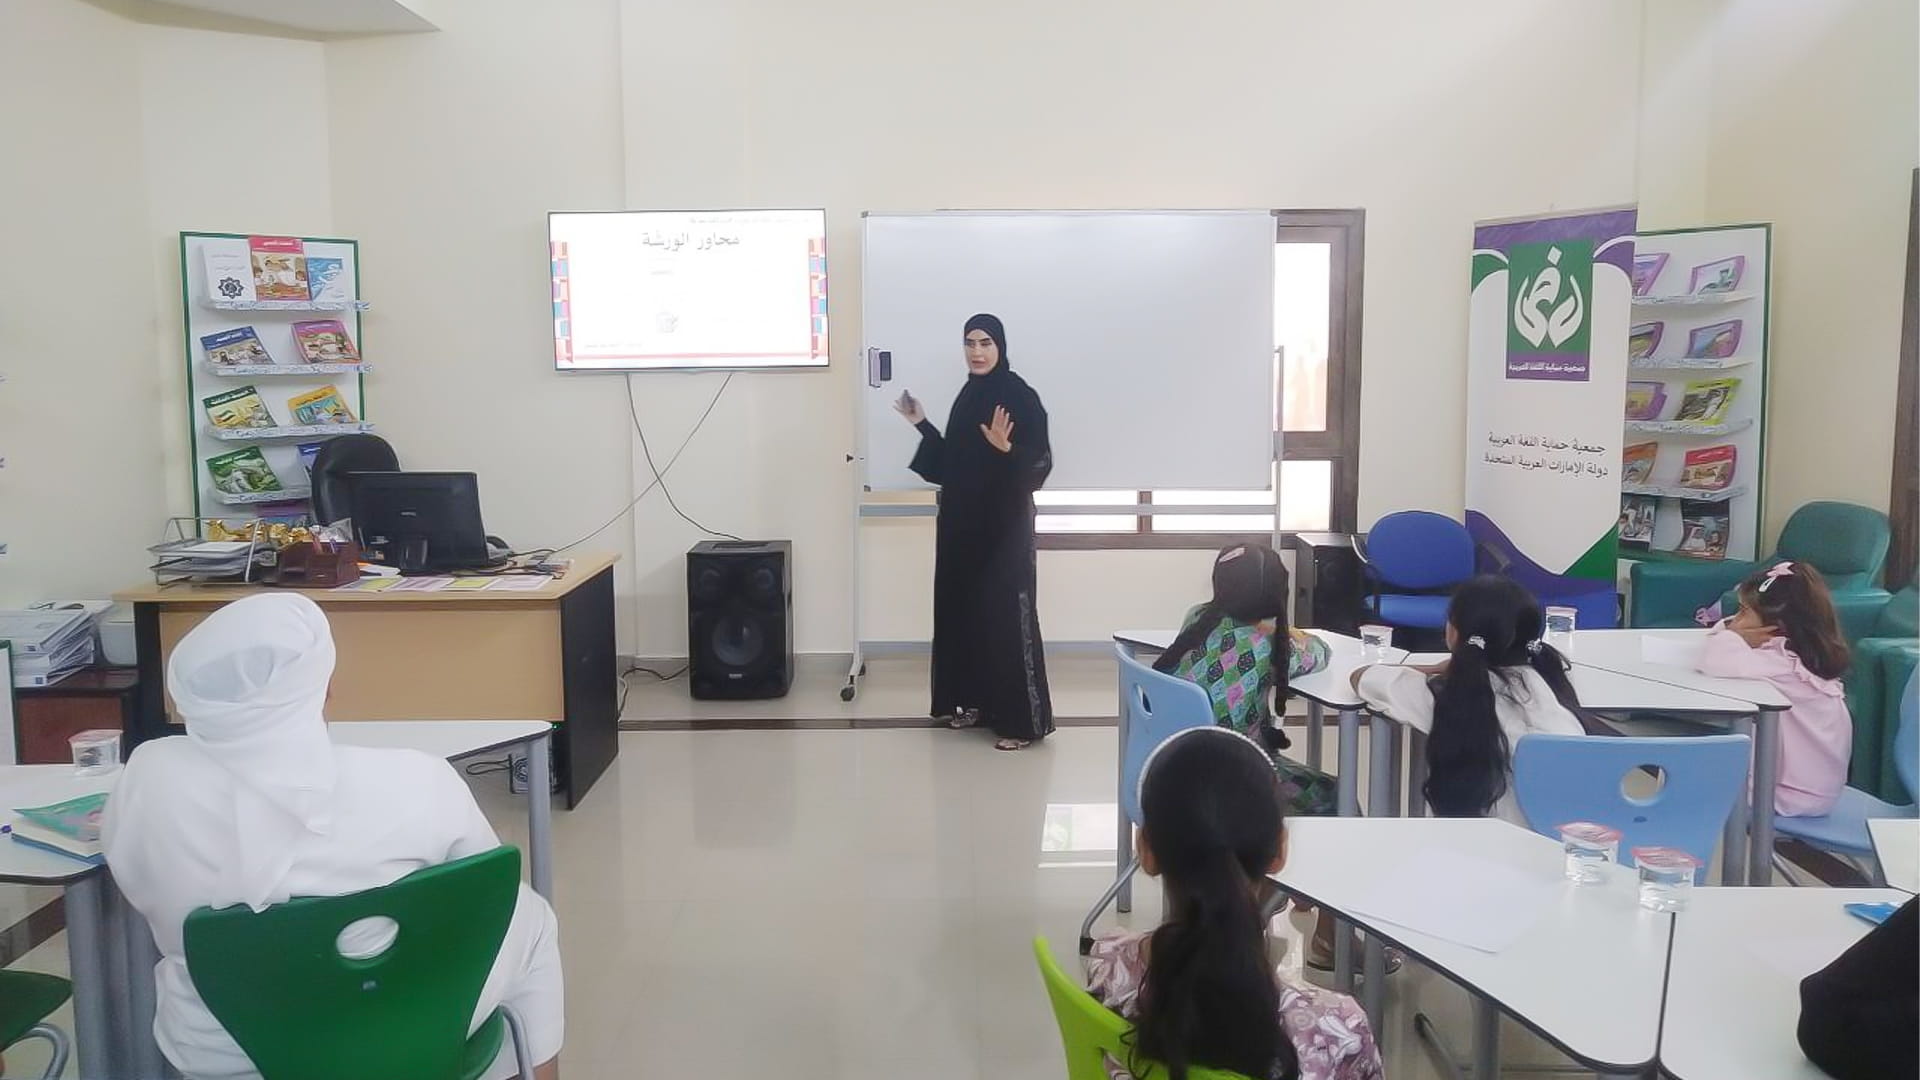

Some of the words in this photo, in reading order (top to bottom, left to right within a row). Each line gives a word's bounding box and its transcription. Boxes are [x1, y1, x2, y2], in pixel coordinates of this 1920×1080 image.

[642, 230, 690, 252] الورشة
[697, 232, 740, 250] محاور
[1488, 431, 1516, 448] العربية
[1518, 433, 1540, 447] اللغة
[1541, 436, 1569, 453] حماية
[1572, 437, 1606, 456] جمعية
[1484, 452, 1516, 465] المتحدة
[1518, 457, 1547, 471] العربية
[1549, 460, 1585, 478] الإمارات
[1586, 462, 1608, 479] دولة
